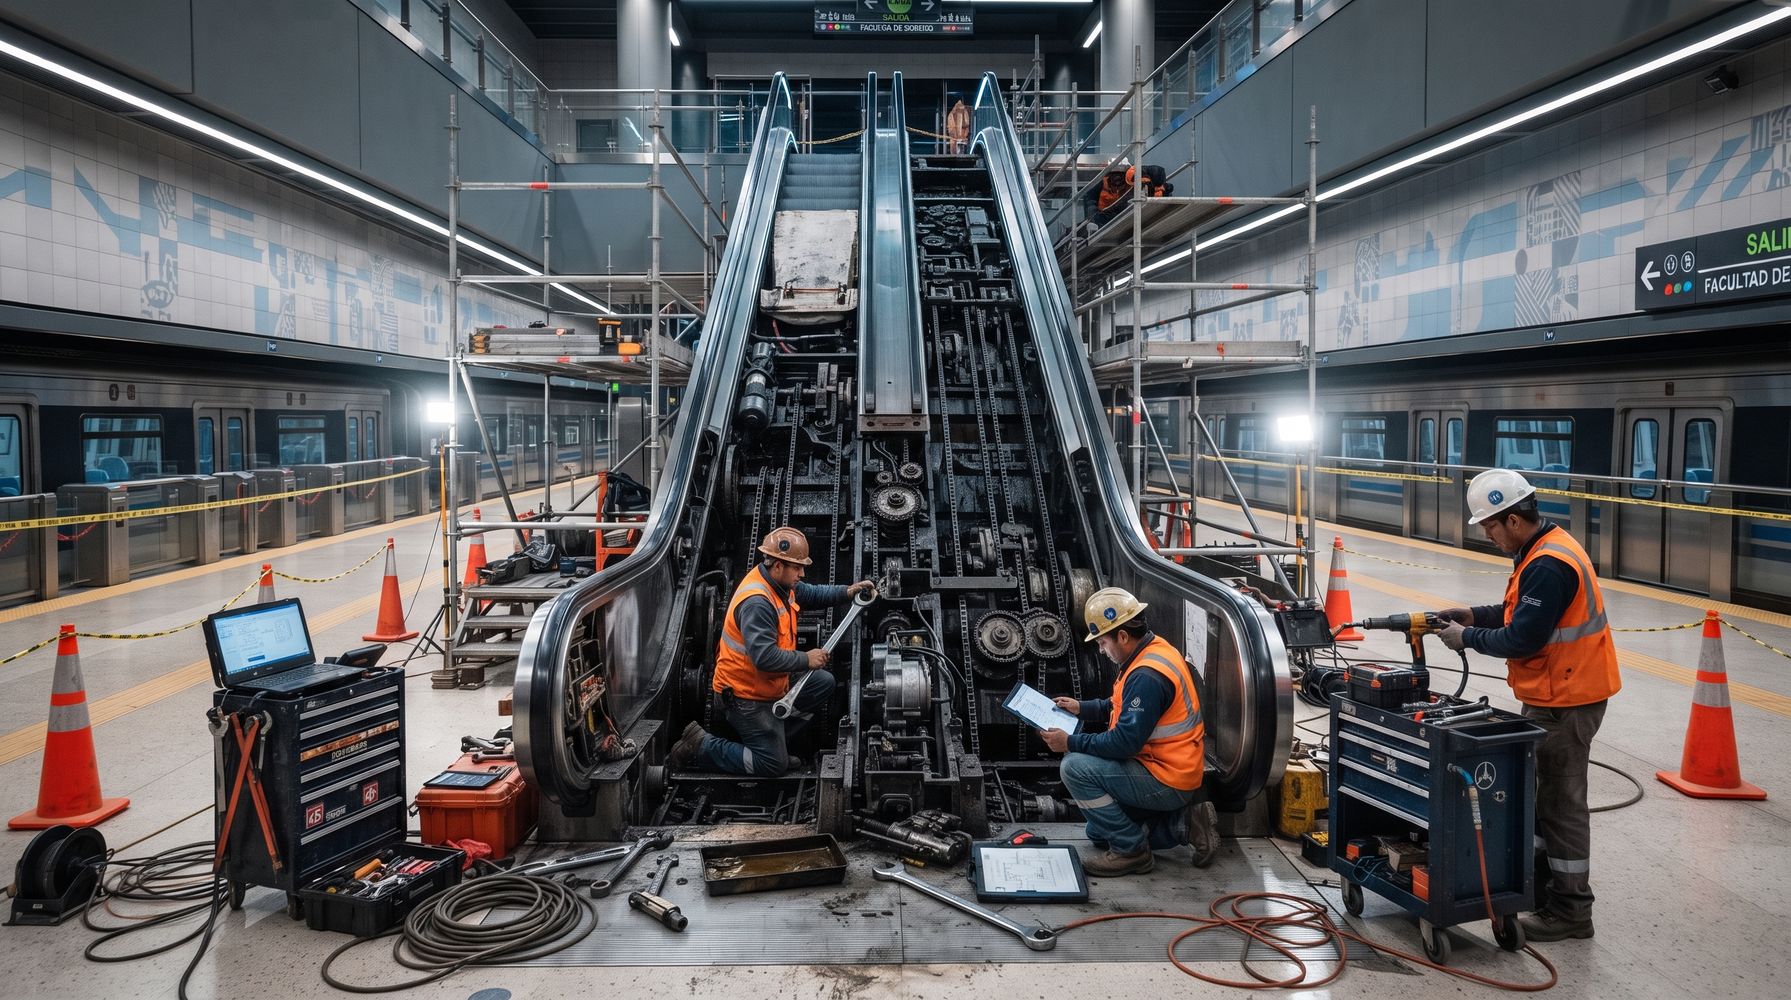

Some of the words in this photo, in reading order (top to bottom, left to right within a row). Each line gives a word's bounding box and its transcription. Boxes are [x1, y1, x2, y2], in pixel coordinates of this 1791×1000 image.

[893, 24, 903, 32] DE
[1705, 269, 1768, 293] FACULTAD
[1772, 265, 1791, 285] DE
